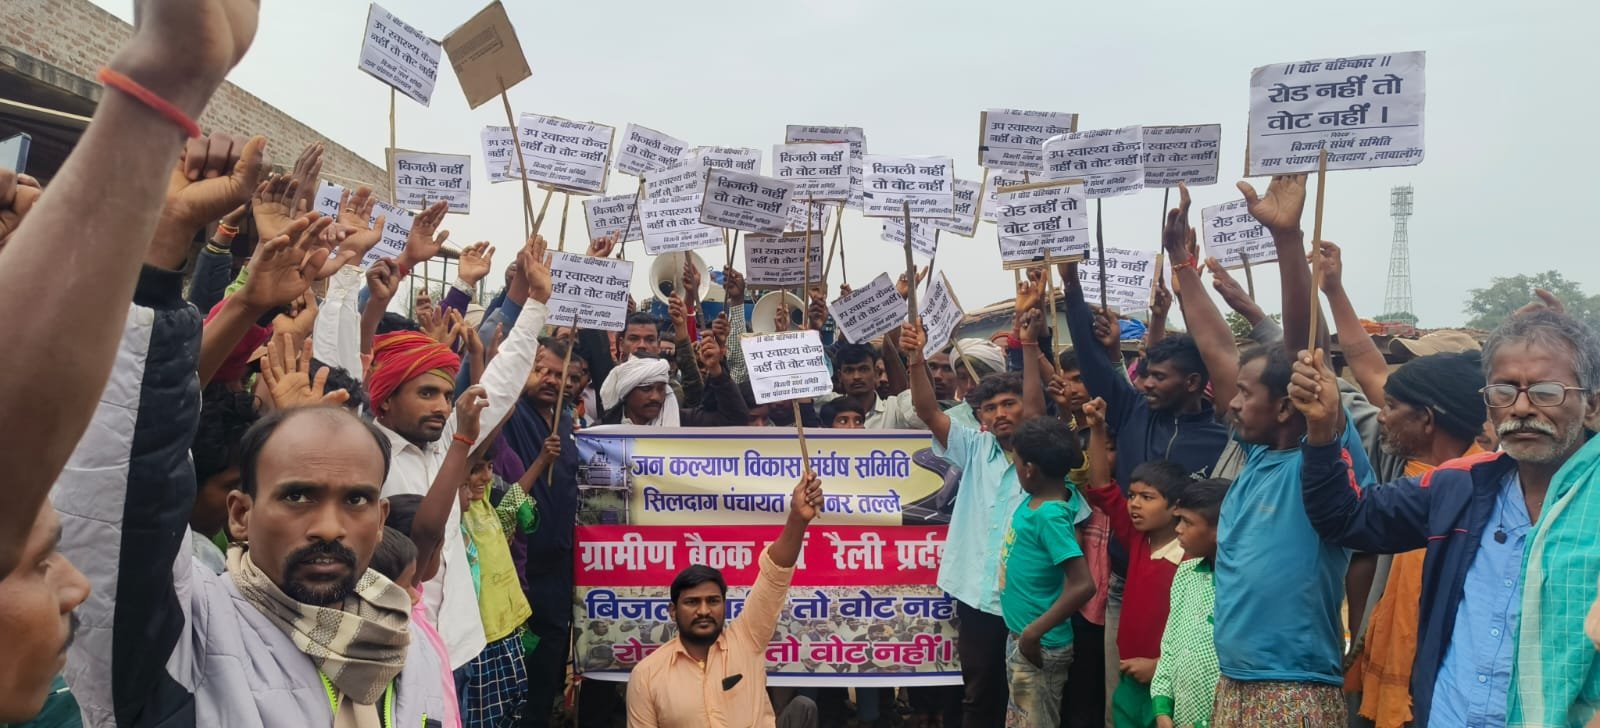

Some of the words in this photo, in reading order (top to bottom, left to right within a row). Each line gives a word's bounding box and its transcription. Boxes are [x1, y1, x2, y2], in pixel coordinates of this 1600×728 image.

[1299, 62, 1321, 74] वोट
[1325, 57, 1376, 71] बहिष्कार
[1268, 83, 1311, 103] रोड
[1315, 75, 1368, 98] नहीं
[1372, 74, 1403, 95] तो
[1267, 111, 1313, 130] वोट
[1318, 103, 1371, 126] नहीं
[630, 132, 661, 150] बिजली
[662, 144, 683, 156] नहीं
[1290, 140, 1325, 152] बिजली
[1330, 137, 1355, 149] संघर्ष
[1360, 136, 1392, 147] समिति
[626, 144, 637, 153] तो
[640, 149, 657, 160] वोट
[780, 152, 816, 162] बिजली
[820, 150, 843, 161] नहीं
[1049, 150, 1064, 159] उप
[1067, 146, 1109, 156] स्वास्थ्य
[399, 160, 436, 172] बिजली
[440, 164, 464, 174] नहीं
[703, 157, 732, 168] बिजली
[736, 159, 755, 170] नहीं
[872, 163, 915, 174] बिजली
[920, 165, 945, 176] नहीं
[1050, 160, 1071, 171] नहीं
[1073, 160, 1086, 169] तो
[1090, 159, 1112, 168] वोट
[780, 166, 792, 176] तो
[796, 166, 816, 175] वोट
[398, 175, 411, 184] तो
[416, 176, 436, 186] वोट
[718, 176, 757, 193] बिजली
[762, 187, 787, 199] नहीं
[872, 178, 888, 190] तो
[892, 179, 916, 190] वोट
[714, 192, 729, 202] तो
[732, 195, 754, 207] वोट
[1002, 205, 1026, 217] रोड
[1029, 199, 1057, 213] नहीं
[1061, 198, 1078, 211] तो
[1003, 222, 1030, 234] वोट
[1032, 216, 1061, 231] नहीं
[1212, 216, 1233, 228] रोड
[1212, 232, 1237, 242] वोट
[1122, 261, 1148, 272] नहीं
[565, 271, 603, 284] स्वास्थ्य
[568, 285, 581, 295] तो
[584, 287, 603, 298] वोट
[749, 352, 763, 360] उप
[766, 347, 800, 357] स्वास्थ्य
[753, 361, 772, 372] नहीं
[774, 360, 785, 370] तो
[788, 359, 806, 368] वोट
[631, 454, 665, 476] जन
[670, 456, 740, 477] कल्याण
[744, 450, 802, 478] विकास
[854, 450, 913, 478] समिति
[643, 486, 719, 512] सिलदाग
[723, 486, 786, 513] पंचायत
[857, 489, 900, 514] तल्ले
[578, 532, 677, 572] ग्रामीण
[684, 532, 755, 570] बैठक
[822, 532, 887, 571] रैली
[792, 590, 831, 619] तो
[838, 590, 898, 620] वोट
[765, 636, 802, 663] तो
[810, 636, 868, 664] वोट
